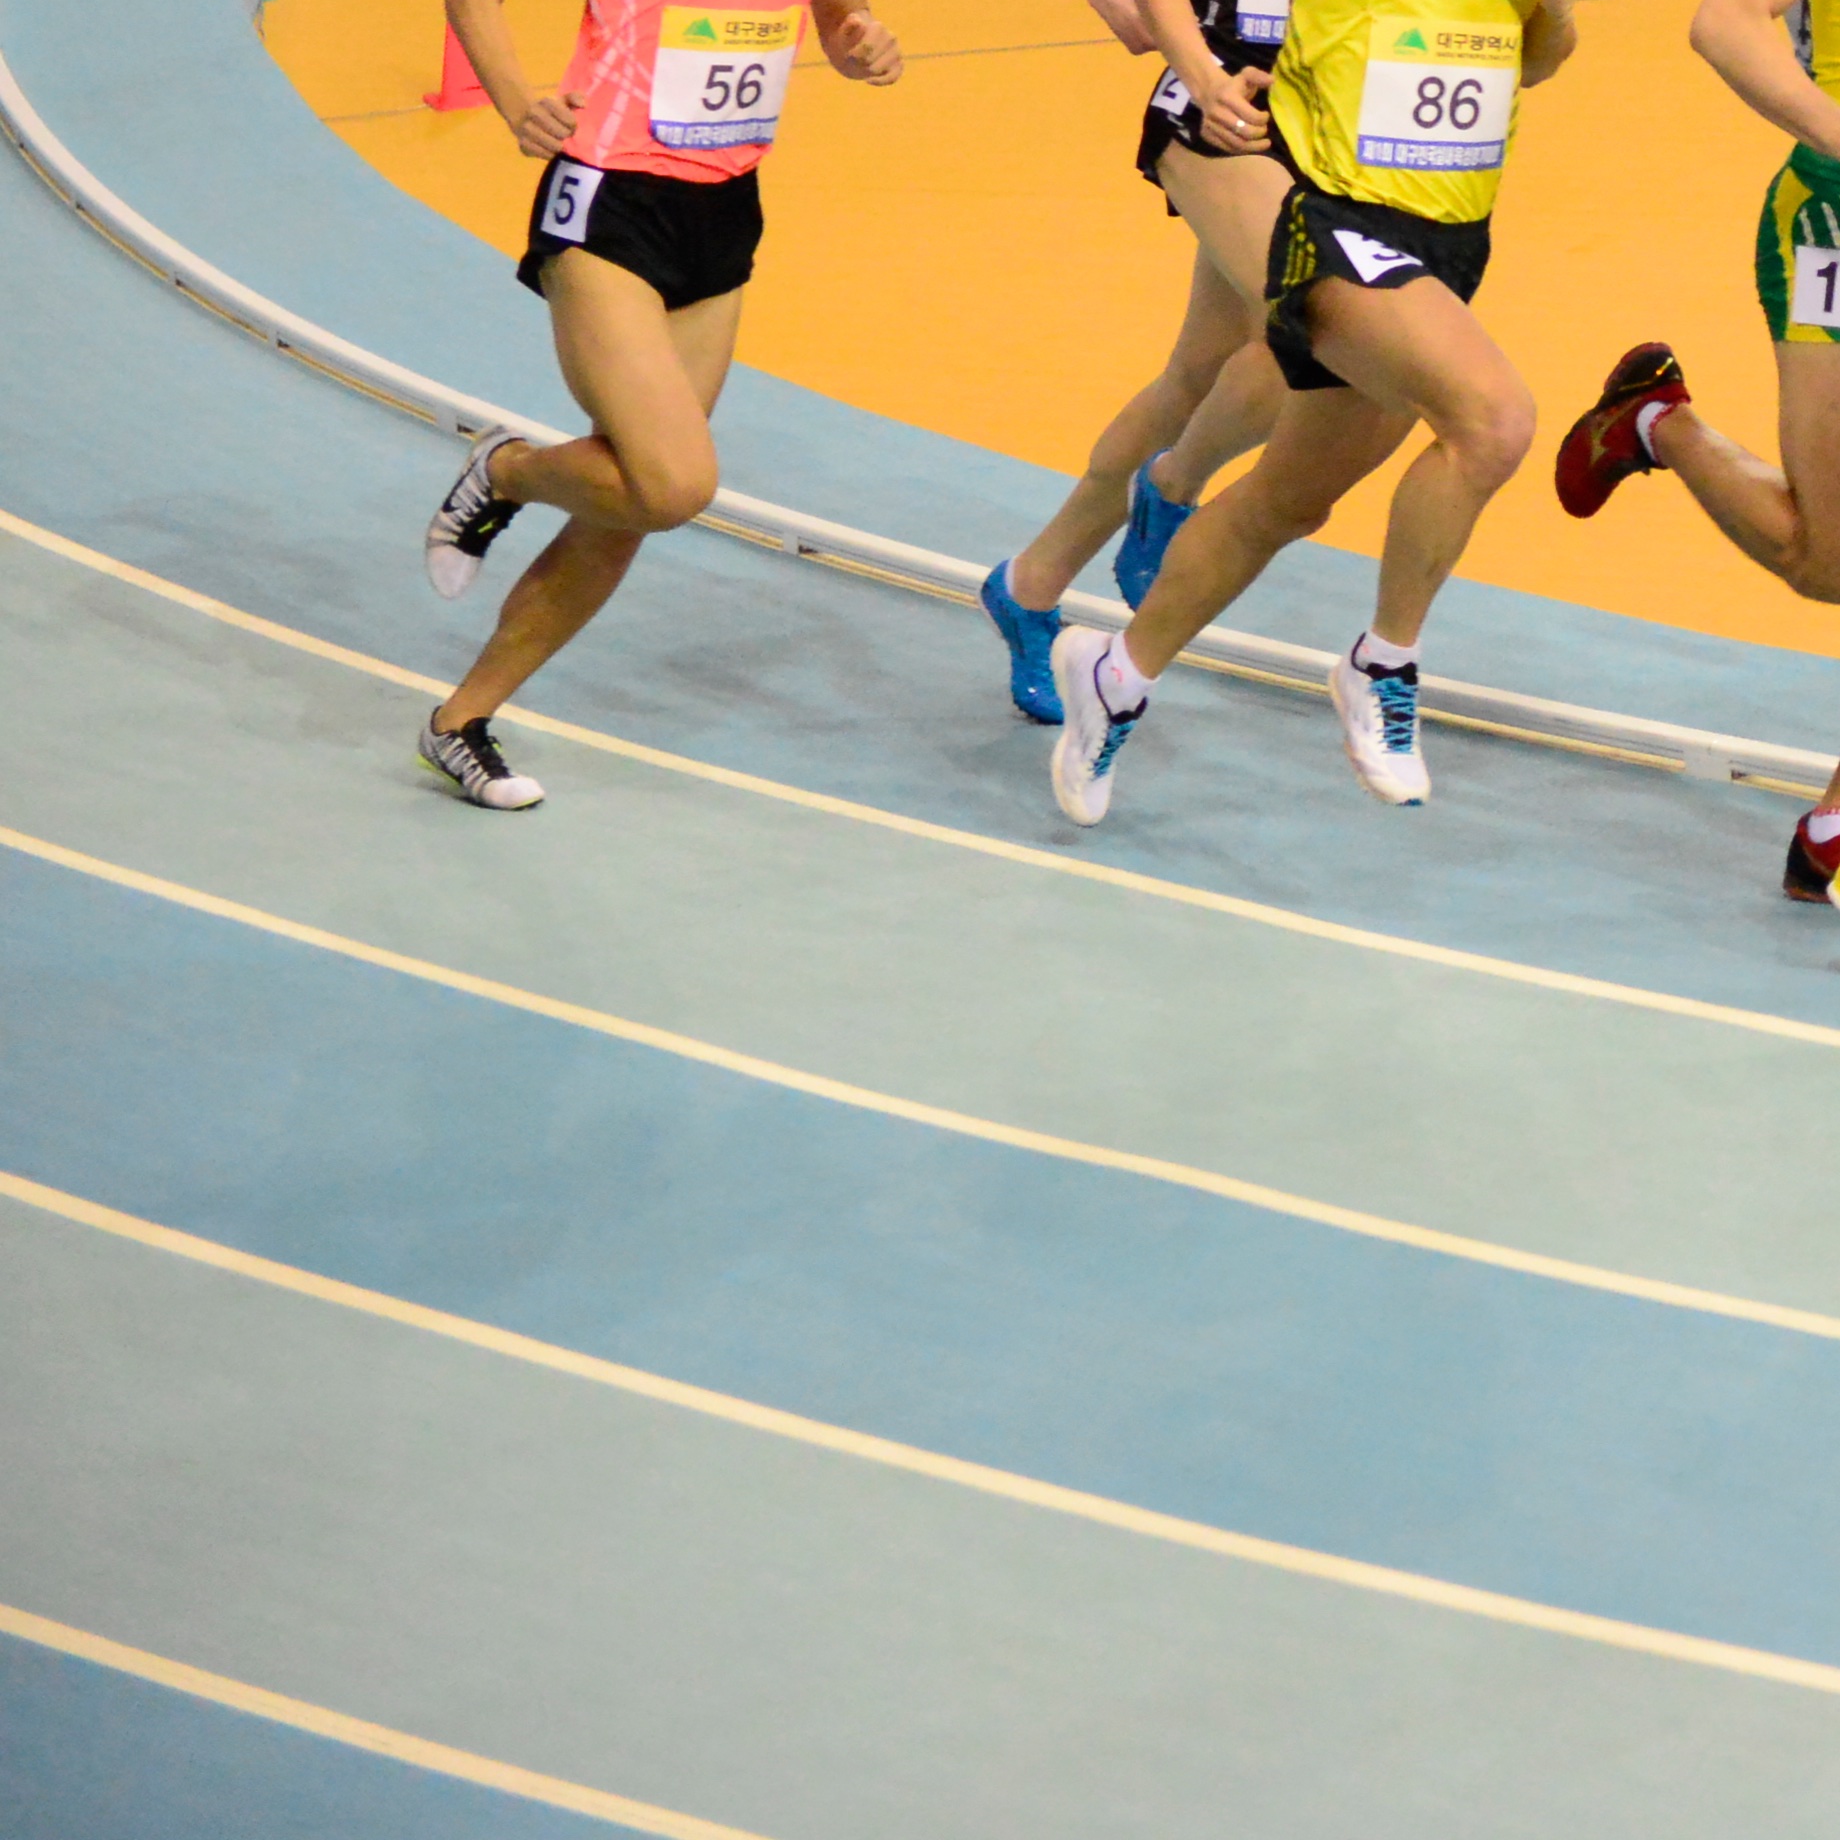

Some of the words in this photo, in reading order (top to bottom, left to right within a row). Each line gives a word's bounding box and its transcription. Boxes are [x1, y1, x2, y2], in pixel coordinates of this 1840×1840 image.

[701, 63, 766, 111] 56
[1412, 75, 1483, 130] 86
[554, 176, 580, 225] 5
[1816, 261, 1838, 313] 1
